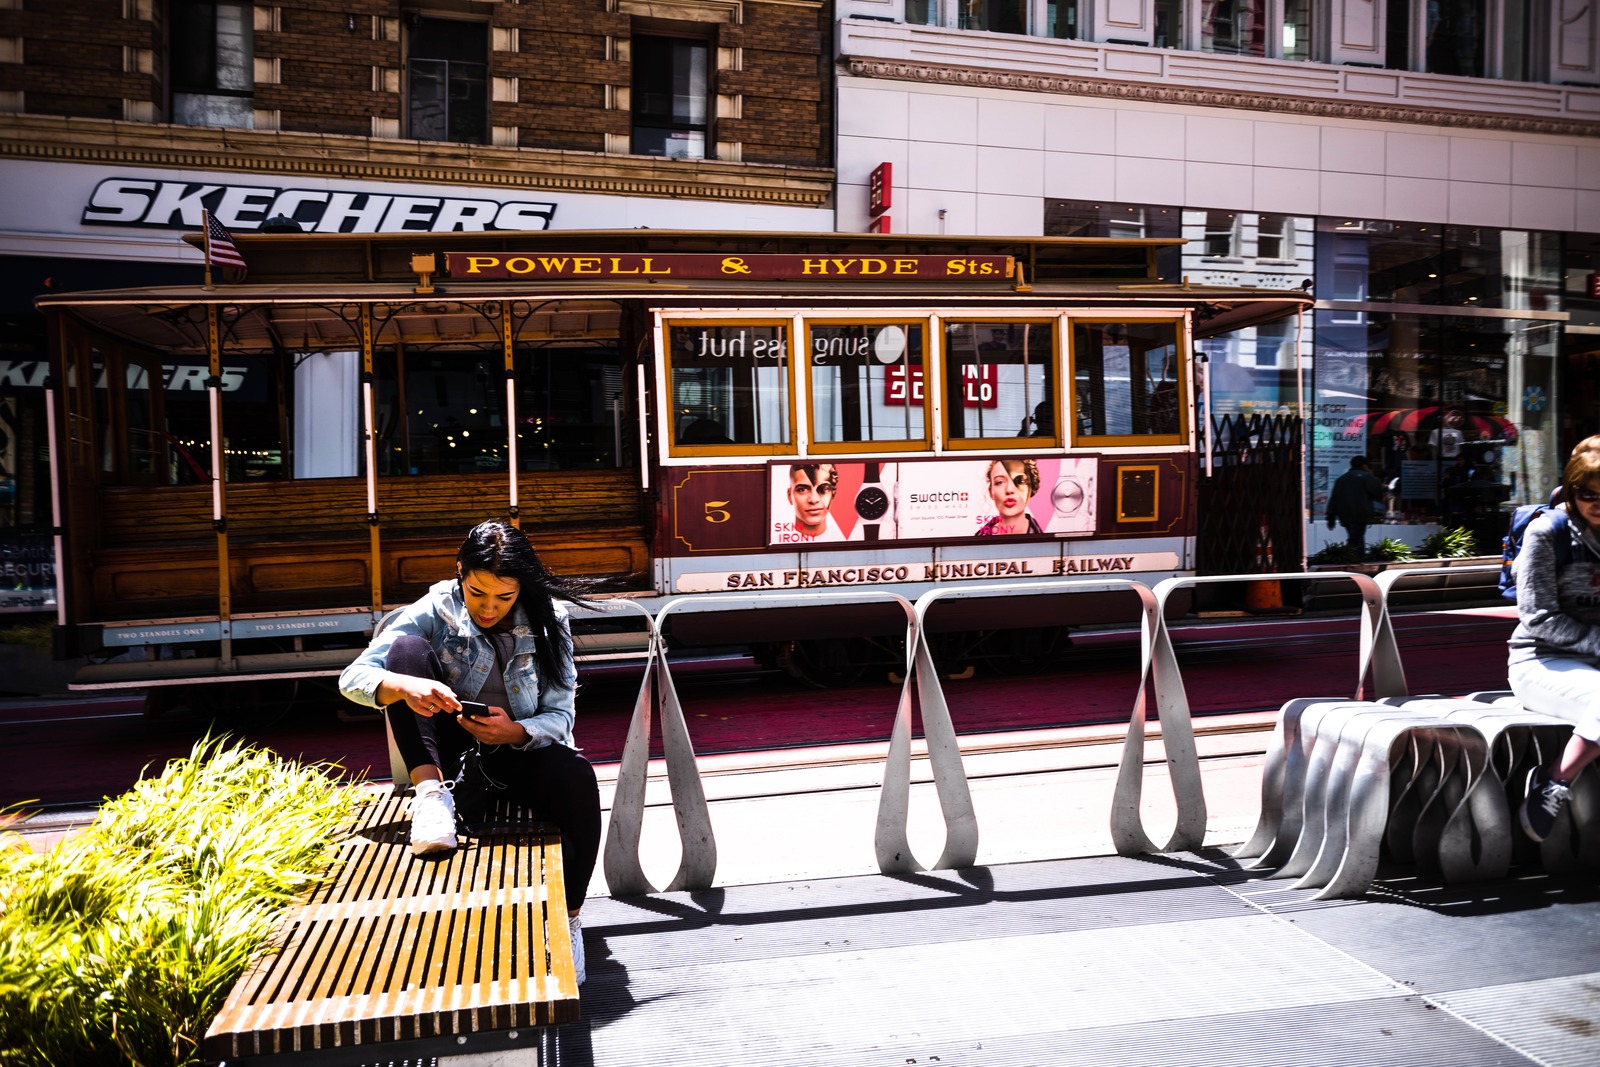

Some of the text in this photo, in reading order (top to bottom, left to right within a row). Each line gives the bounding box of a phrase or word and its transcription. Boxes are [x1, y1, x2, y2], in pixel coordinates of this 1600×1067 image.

[82, 178, 557, 232] SKECHERS
[466, 256, 1000, 275] POWELL & HYDE Sts.
[963, 383, 993, 401] LO
[910, 491, 960, 503] swatch
[704, 500, 731, 523] 5
[976, 515, 1004, 525] SKIN
[774, 522, 805, 532] SKIN
[979, 525, 1016, 535] IRONY
[778, 533, 817, 543] IRONY
[727, 556, 1135, 588] SAN FRANCISCO MUNICIPAL RAILWAY
[276, 622, 316, 630] STANDEES
[318, 620, 339, 628] ONLY
[139, 629, 181, 638] STANDEES
